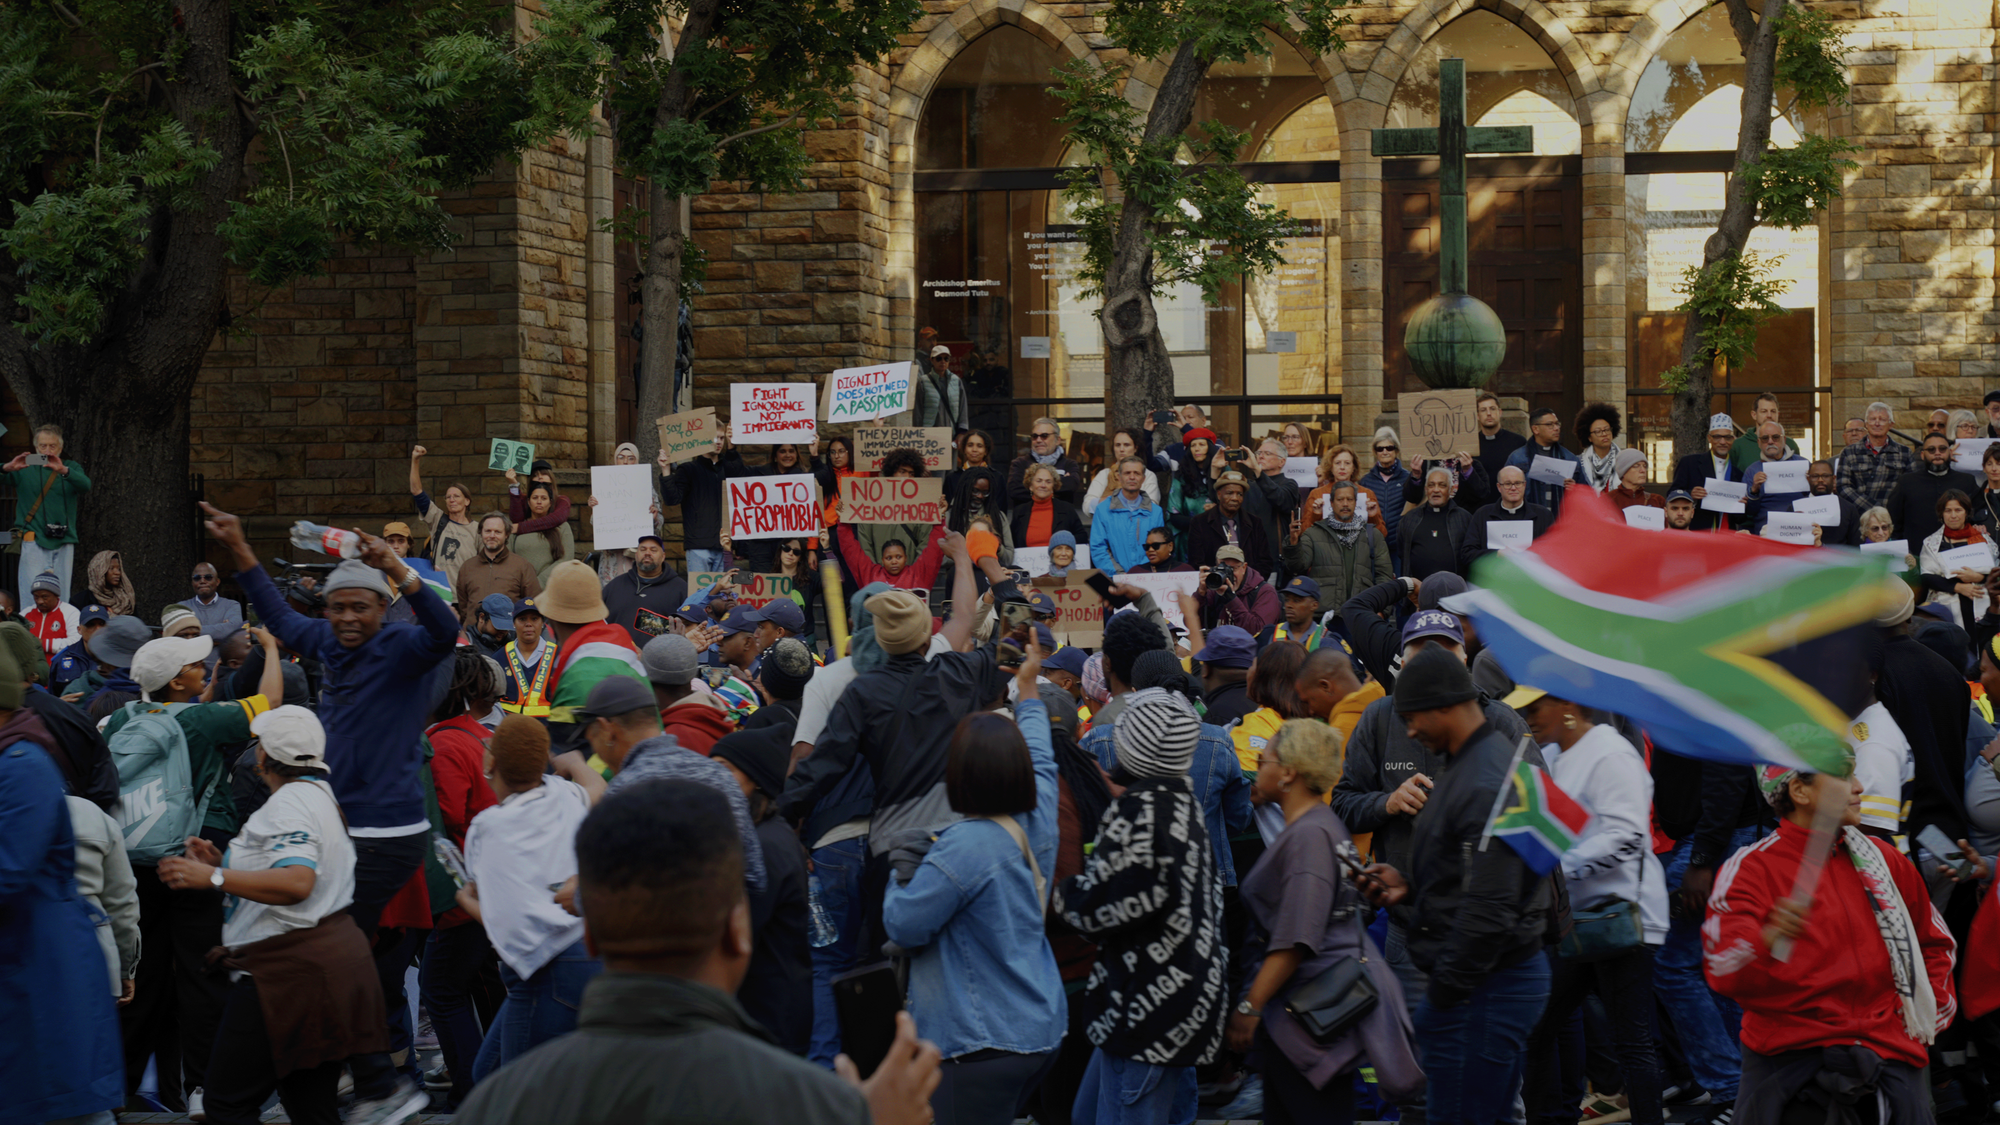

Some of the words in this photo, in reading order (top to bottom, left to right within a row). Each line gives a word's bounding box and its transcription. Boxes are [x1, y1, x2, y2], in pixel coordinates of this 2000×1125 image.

[922, 280, 966, 288] Archbishop
[934, 290, 970, 298] Desmond
[837, 370, 890, 390] DIGNITY
[753, 388, 790, 400] FIGHT
[836, 388, 864, 401] DOES
[865, 384, 884, 396] NOT
[885, 380, 908, 392] NEED
[742, 400, 805, 412] IGNORANCE
[832, 404, 848, 416] A
[850, 390, 906, 416] PASSPORT
[760, 411, 785, 421] NOT
[686, 418, 703, 430] NO
[742, 418, 815, 434] IMMIGRANTS
[1409, 412, 1476, 437] UBUNTU
[678, 430, 692, 438] TO
[857, 428, 889, 441] THEY
[890, 428, 926, 440] BLAME
[864, 440, 924, 449] IMMIGRANTS
[924, 440, 938, 448] SO
[1544, 468, 1561, 476] PEACE
[730, 482, 767, 508] NO
[775, 482, 809, 504] TO
[851, 479, 884, 502] NO
[886, 478, 919, 501] TO
[1708, 490, 1740, 500] COMPASSION
[730, 500, 826, 536] AFROPHOBIA
[848, 502, 942, 522] XENOPHOBIA
[1638, 514, 1652, 522] PEACE
[1949, 552, 1985, 561] COMPASSION
[766, 576, 792, 596] TO
[1118, 576, 1130, 584] WE
[1054, 589, 1081, 602] TO
[510, 651, 530, 694] POLICE
[534, 648, 553, 690] POLICE
